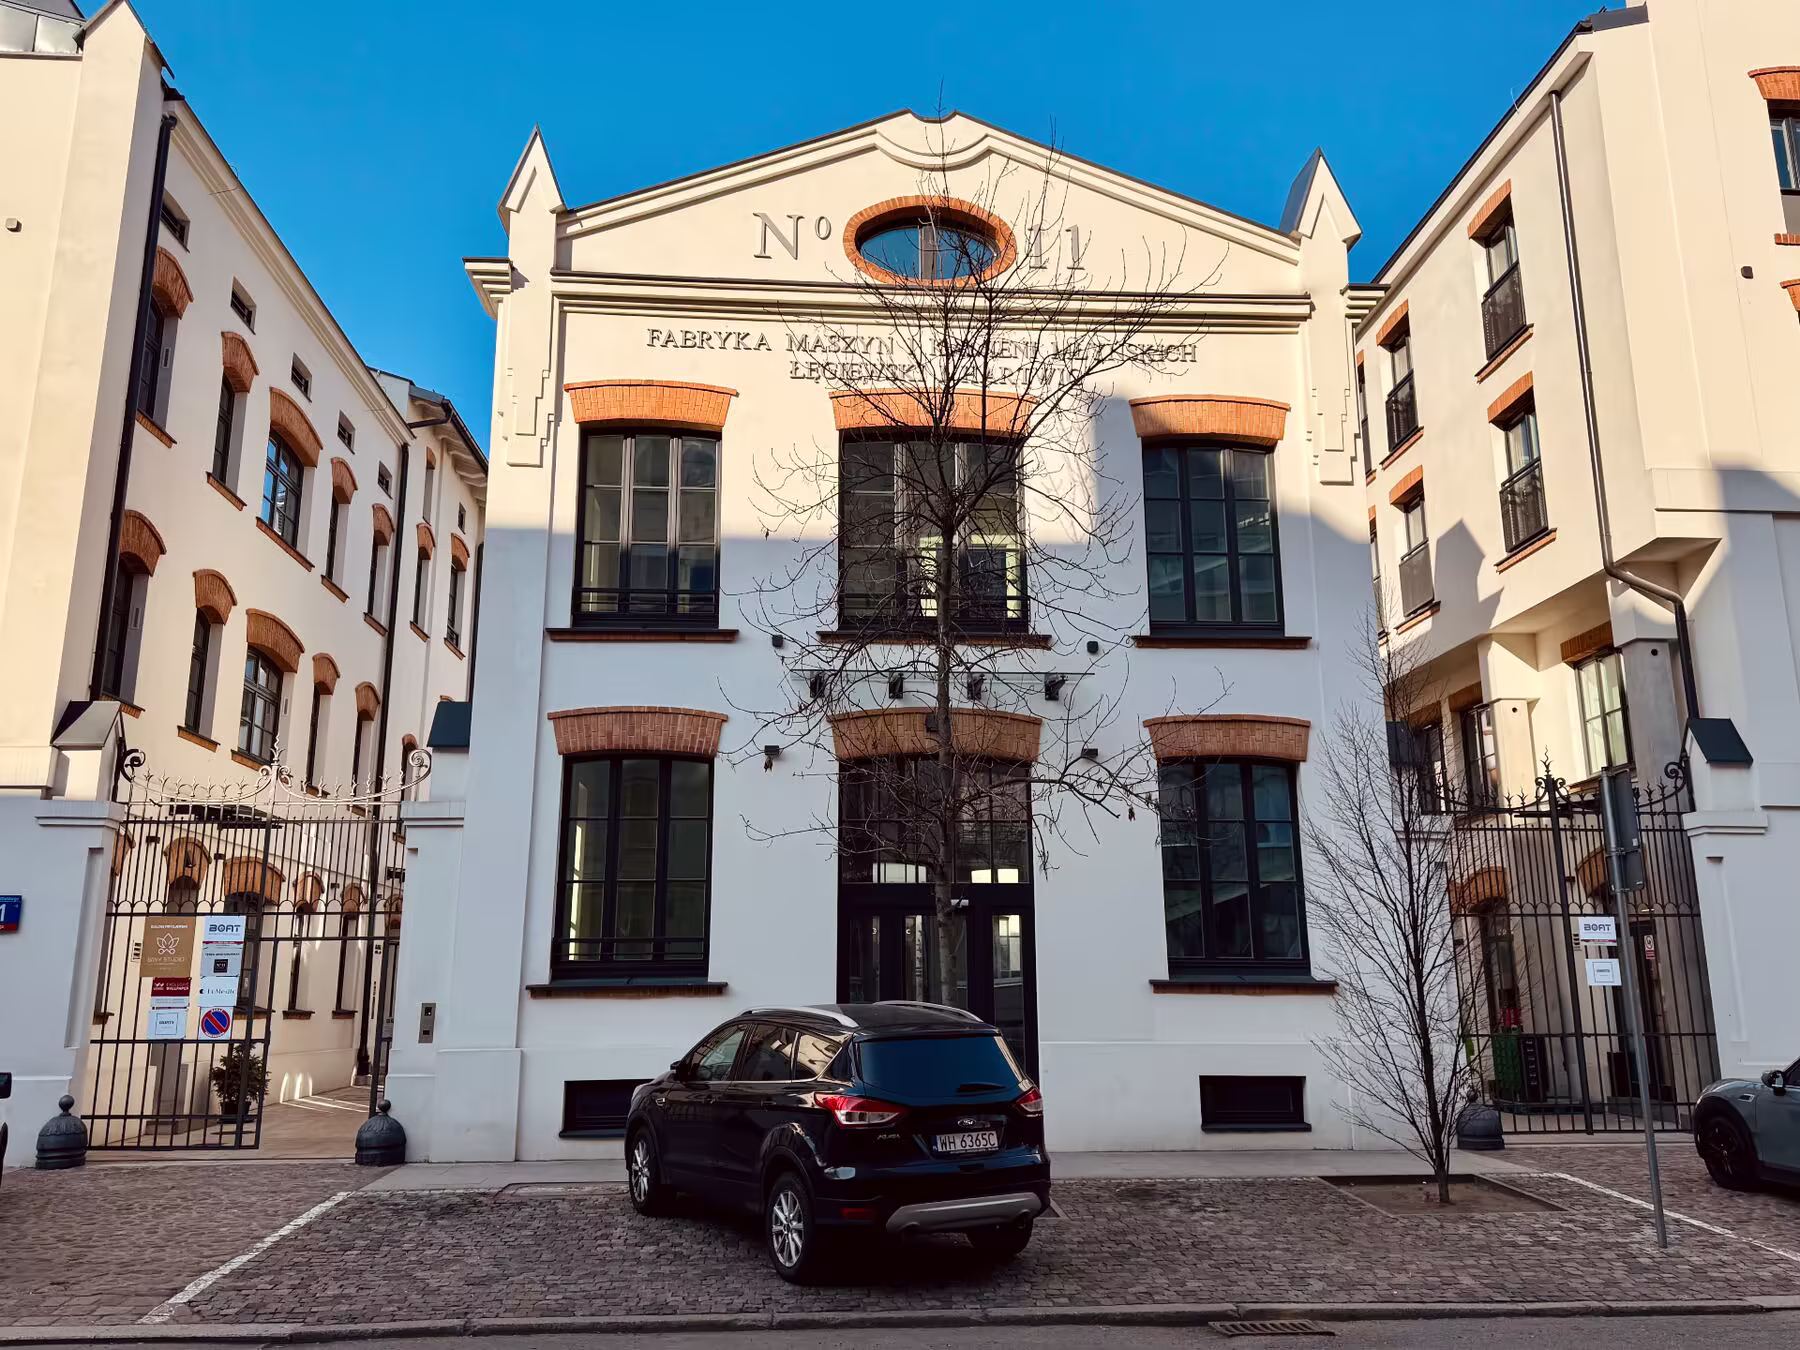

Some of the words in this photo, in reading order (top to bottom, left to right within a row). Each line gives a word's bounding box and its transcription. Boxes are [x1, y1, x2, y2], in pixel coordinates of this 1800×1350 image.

[1026, 222, 1087, 271] 11
[646, 328, 773, 352] FABRYKA
[785, 332, 895, 355] MASZYN
[938, 1134, 956, 1151] WH
[960, 1132, 996, 1149] 6365C
